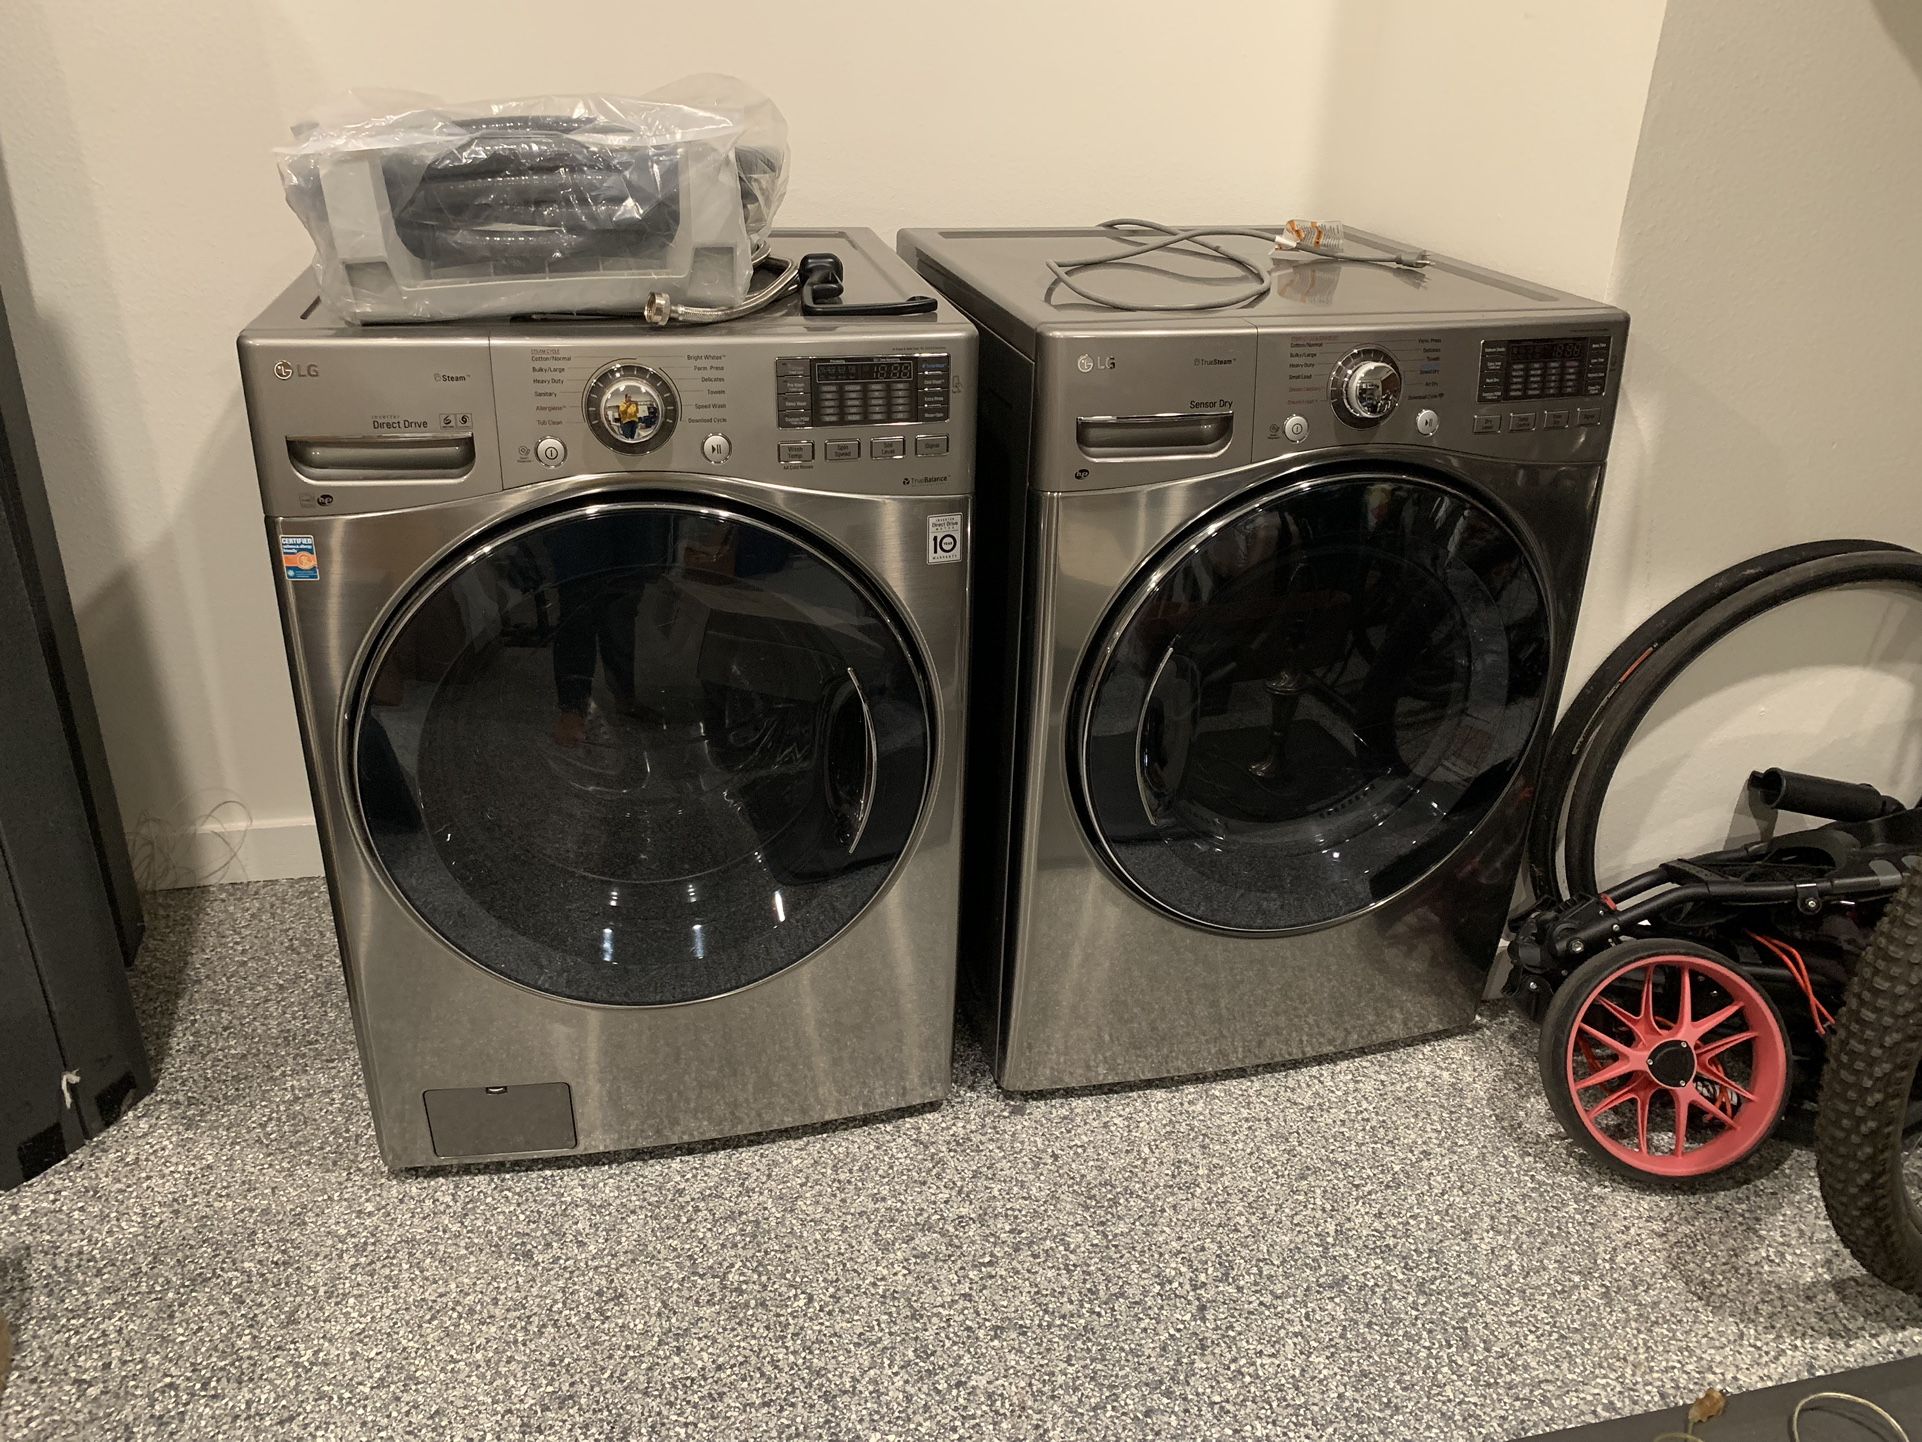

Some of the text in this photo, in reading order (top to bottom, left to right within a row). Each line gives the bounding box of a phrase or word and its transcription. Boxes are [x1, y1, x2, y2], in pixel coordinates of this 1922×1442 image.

[1098, 356, 1116, 369] LG
[297, 364, 318, 378] LG
[1190, 399, 1233, 409] Sensor Dry
[373, 420, 428, 429] Direct Drive
[911, 476, 947, 484] TrueBalance
[933, 534, 957, 554] 10
